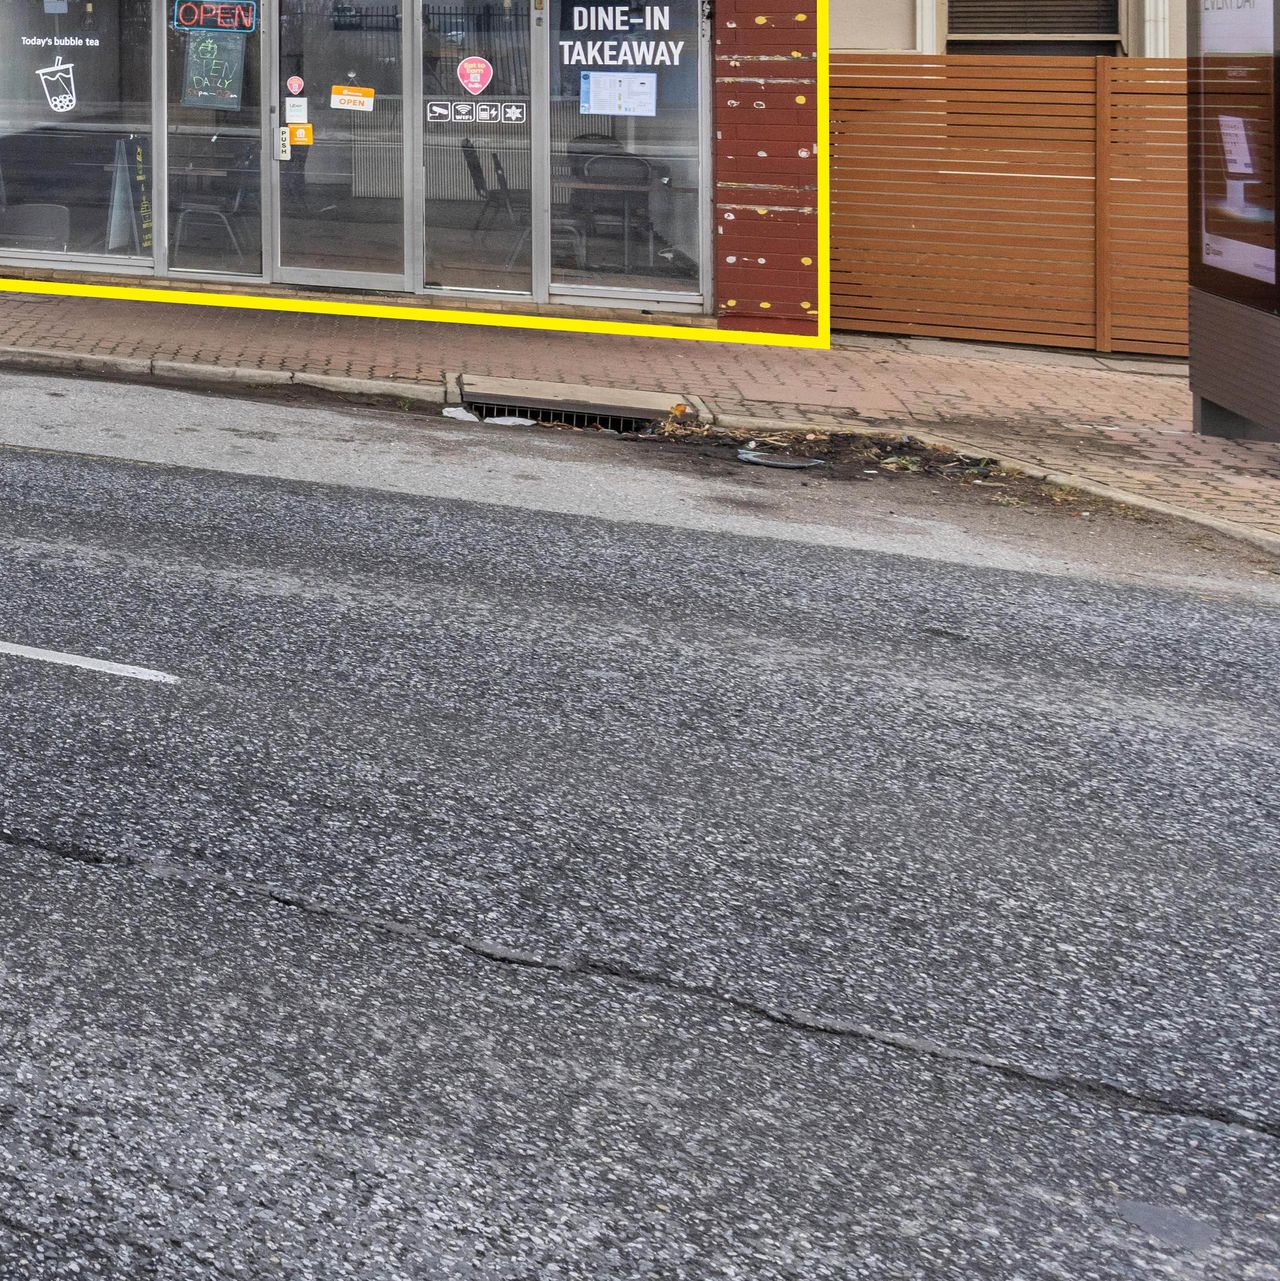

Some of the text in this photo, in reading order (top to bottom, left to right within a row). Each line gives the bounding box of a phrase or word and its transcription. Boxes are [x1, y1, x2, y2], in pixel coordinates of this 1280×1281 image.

[178, 2, 254, 28] OPEN
[573, 6, 670, 31] DINE-IN
[21, 36, 100, 47] Today's bubble tea
[559, 40, 684, 66] TAKEAWAY
[339, 98, 365, 107] OPEN
